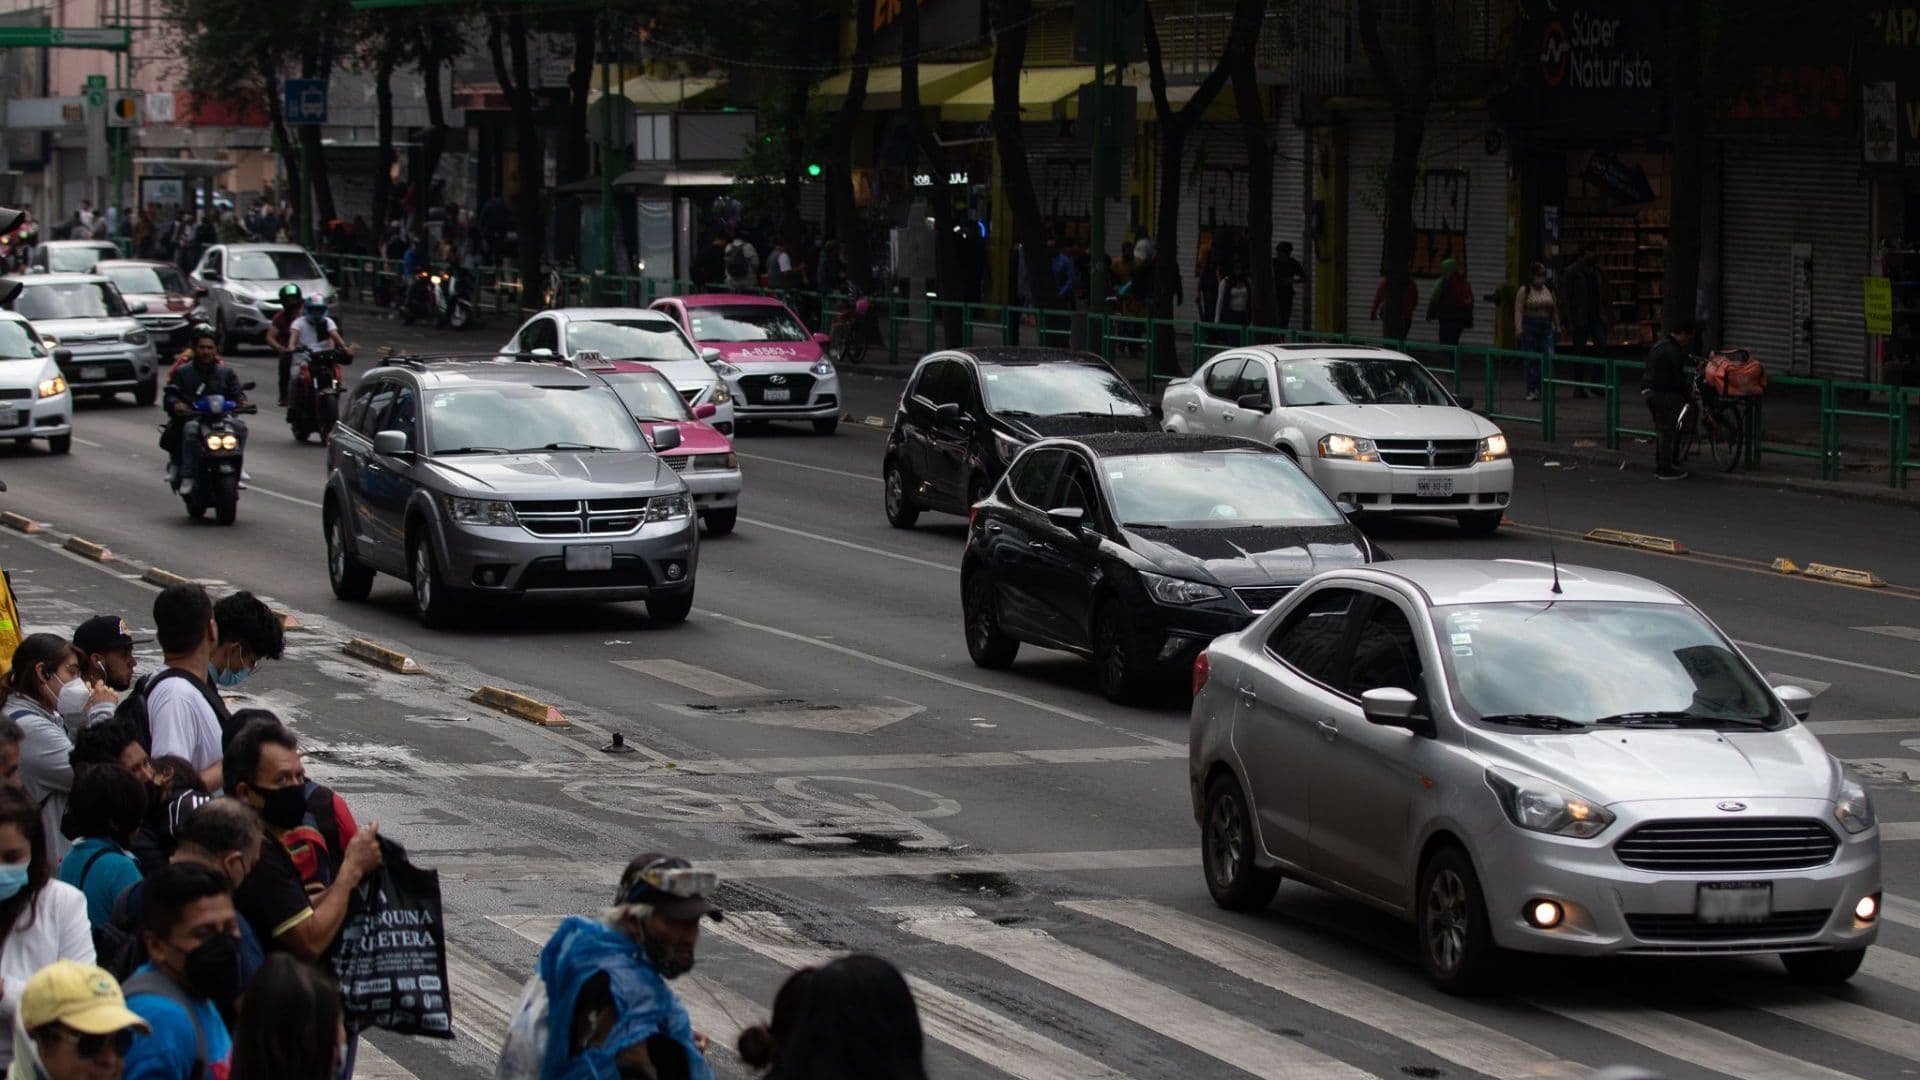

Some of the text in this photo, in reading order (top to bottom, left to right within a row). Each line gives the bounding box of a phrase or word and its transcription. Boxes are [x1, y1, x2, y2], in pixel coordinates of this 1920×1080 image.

[1570, 10, 1620, 54] Súper
[1569, 50, 1653, 88] Naturista
[579, 352, 600, 360] TAXI
